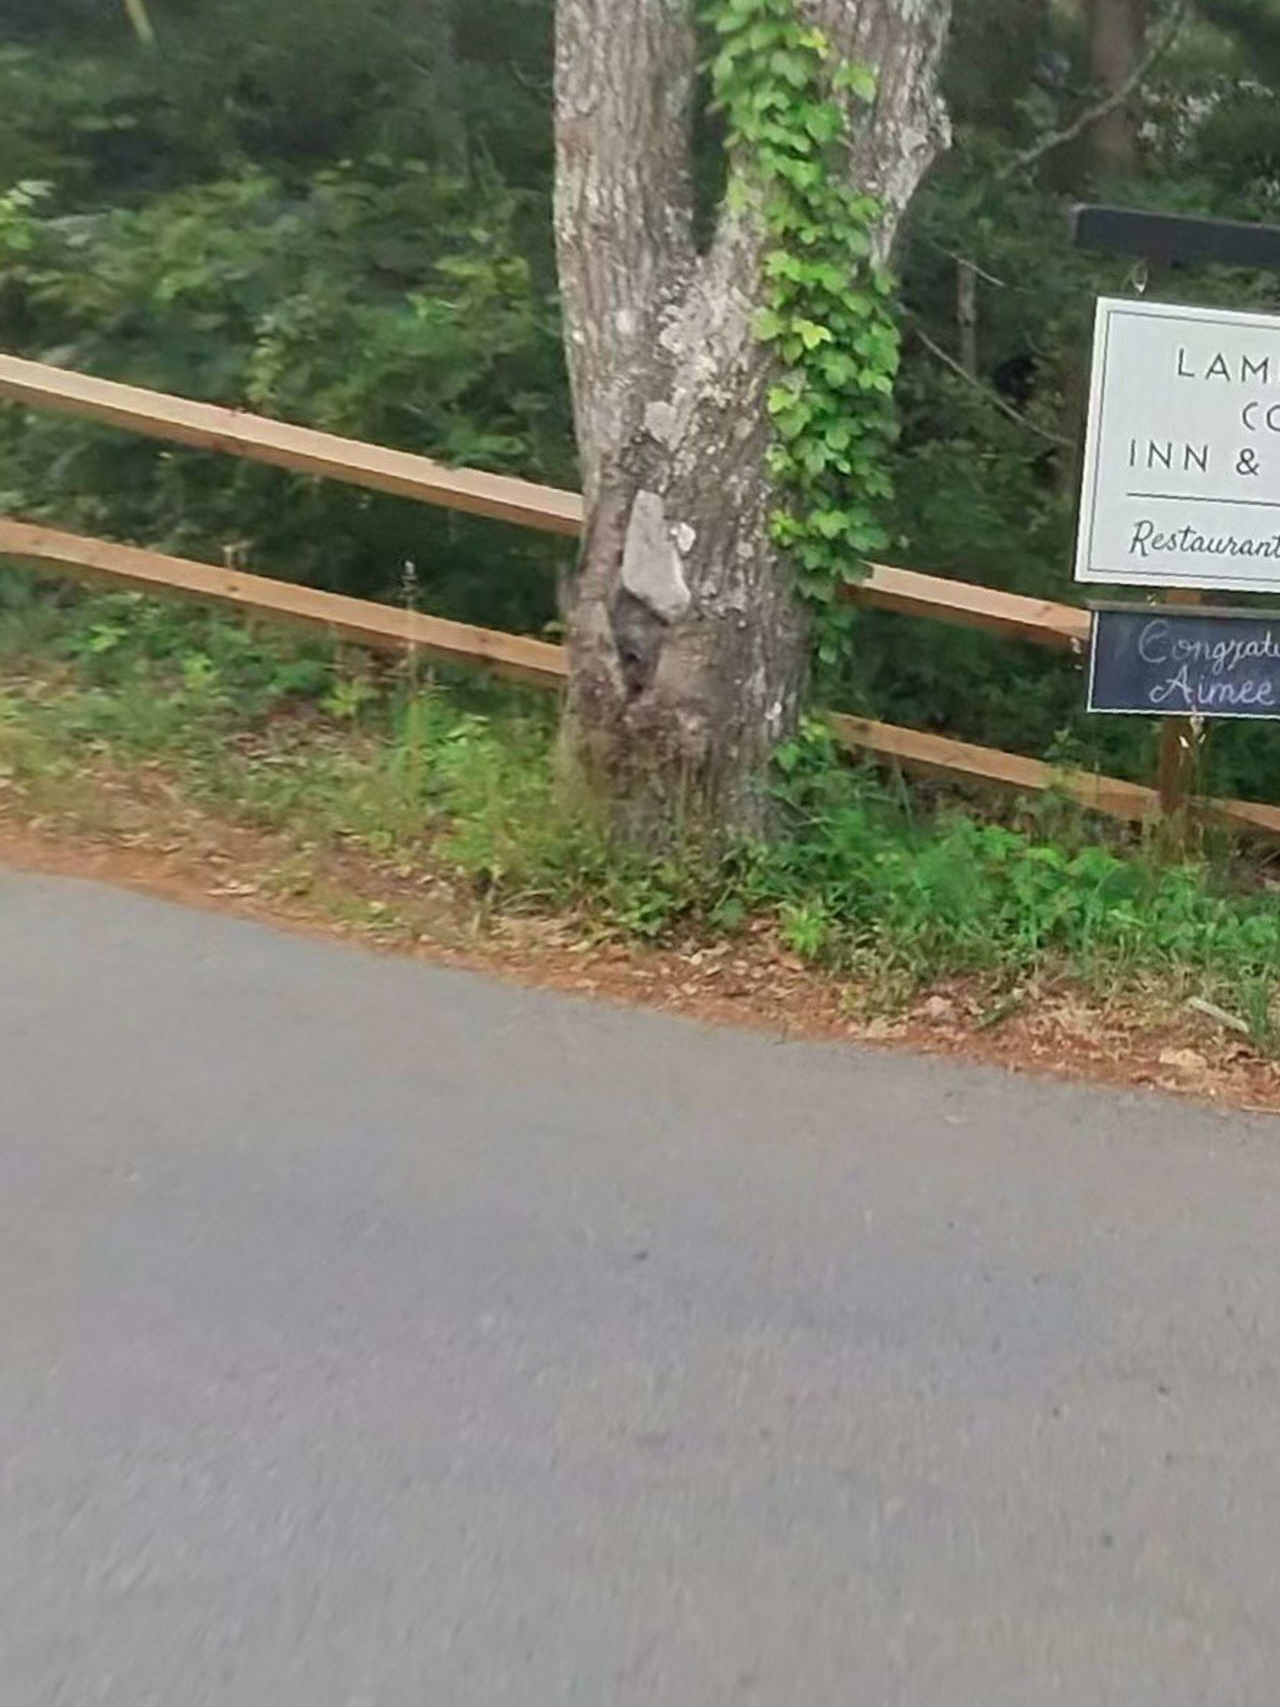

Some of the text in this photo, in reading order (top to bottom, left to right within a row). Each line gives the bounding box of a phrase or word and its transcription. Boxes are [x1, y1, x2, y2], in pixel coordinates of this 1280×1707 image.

[1128, 439, 1209, 472] INN
[1234, 450, 1261, 477] &
[1149, 665, 1276, 706] Aimee
